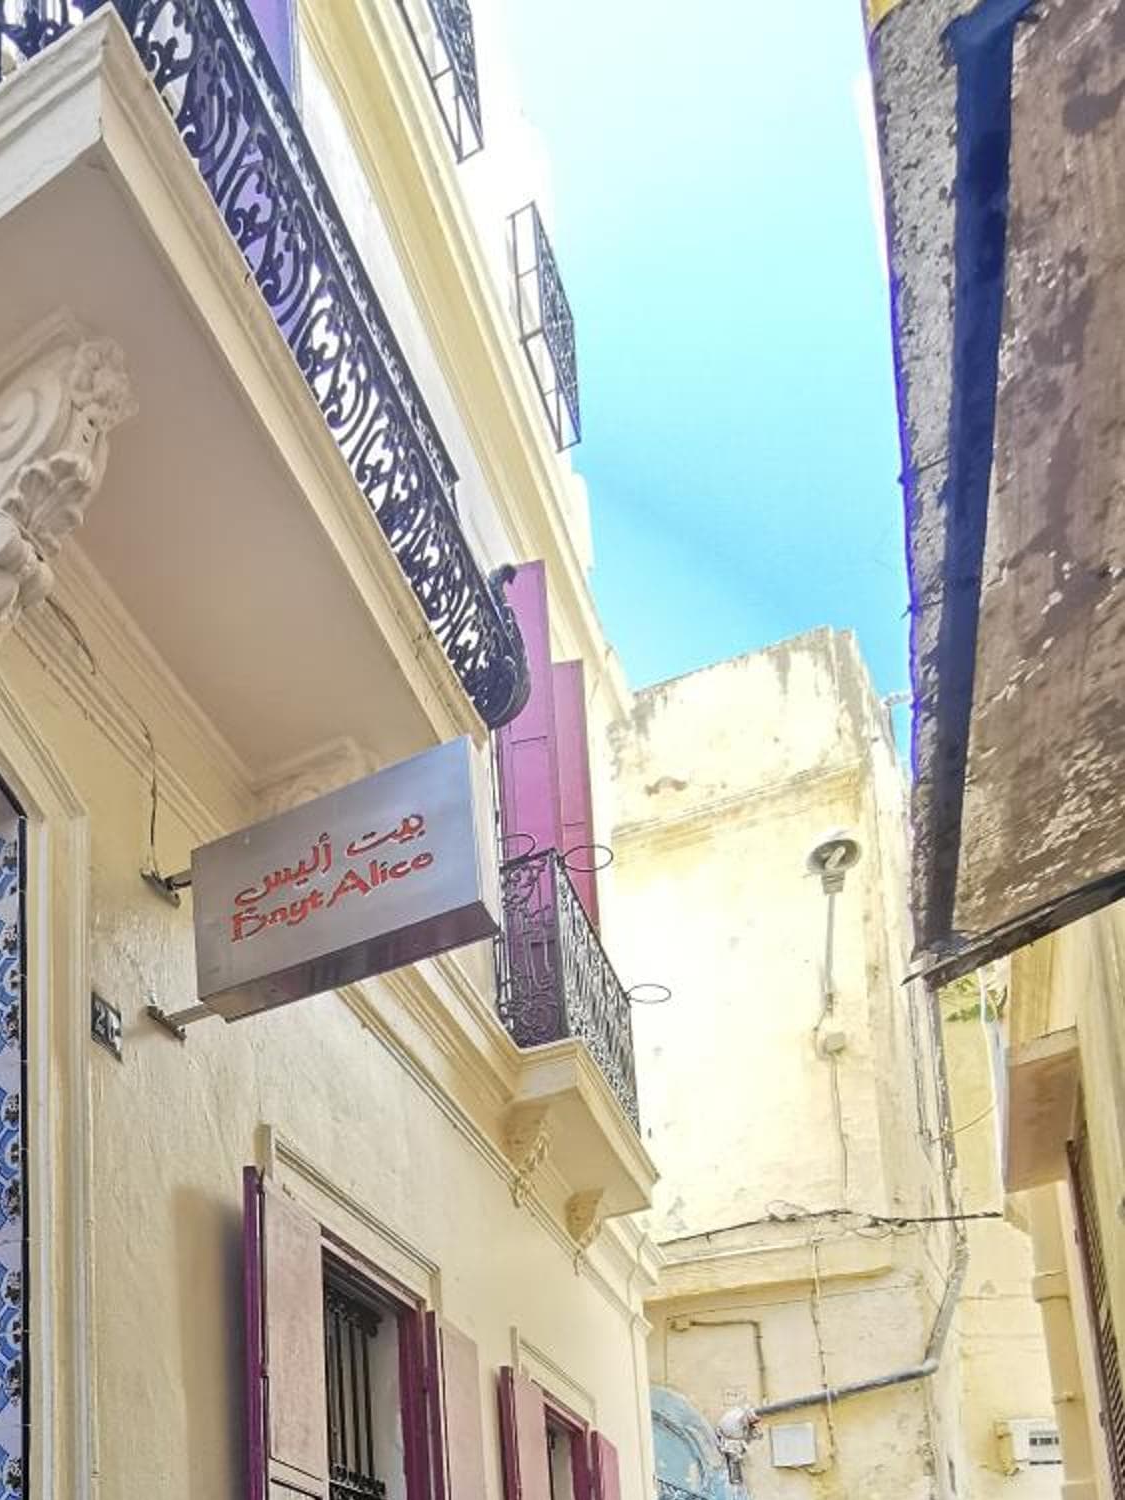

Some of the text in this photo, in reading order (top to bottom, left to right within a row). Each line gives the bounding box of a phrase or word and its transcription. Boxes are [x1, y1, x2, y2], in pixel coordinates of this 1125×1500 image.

[234, 813, 425, 907] بيت أليس
[326, 851, 434, 909] Alice
